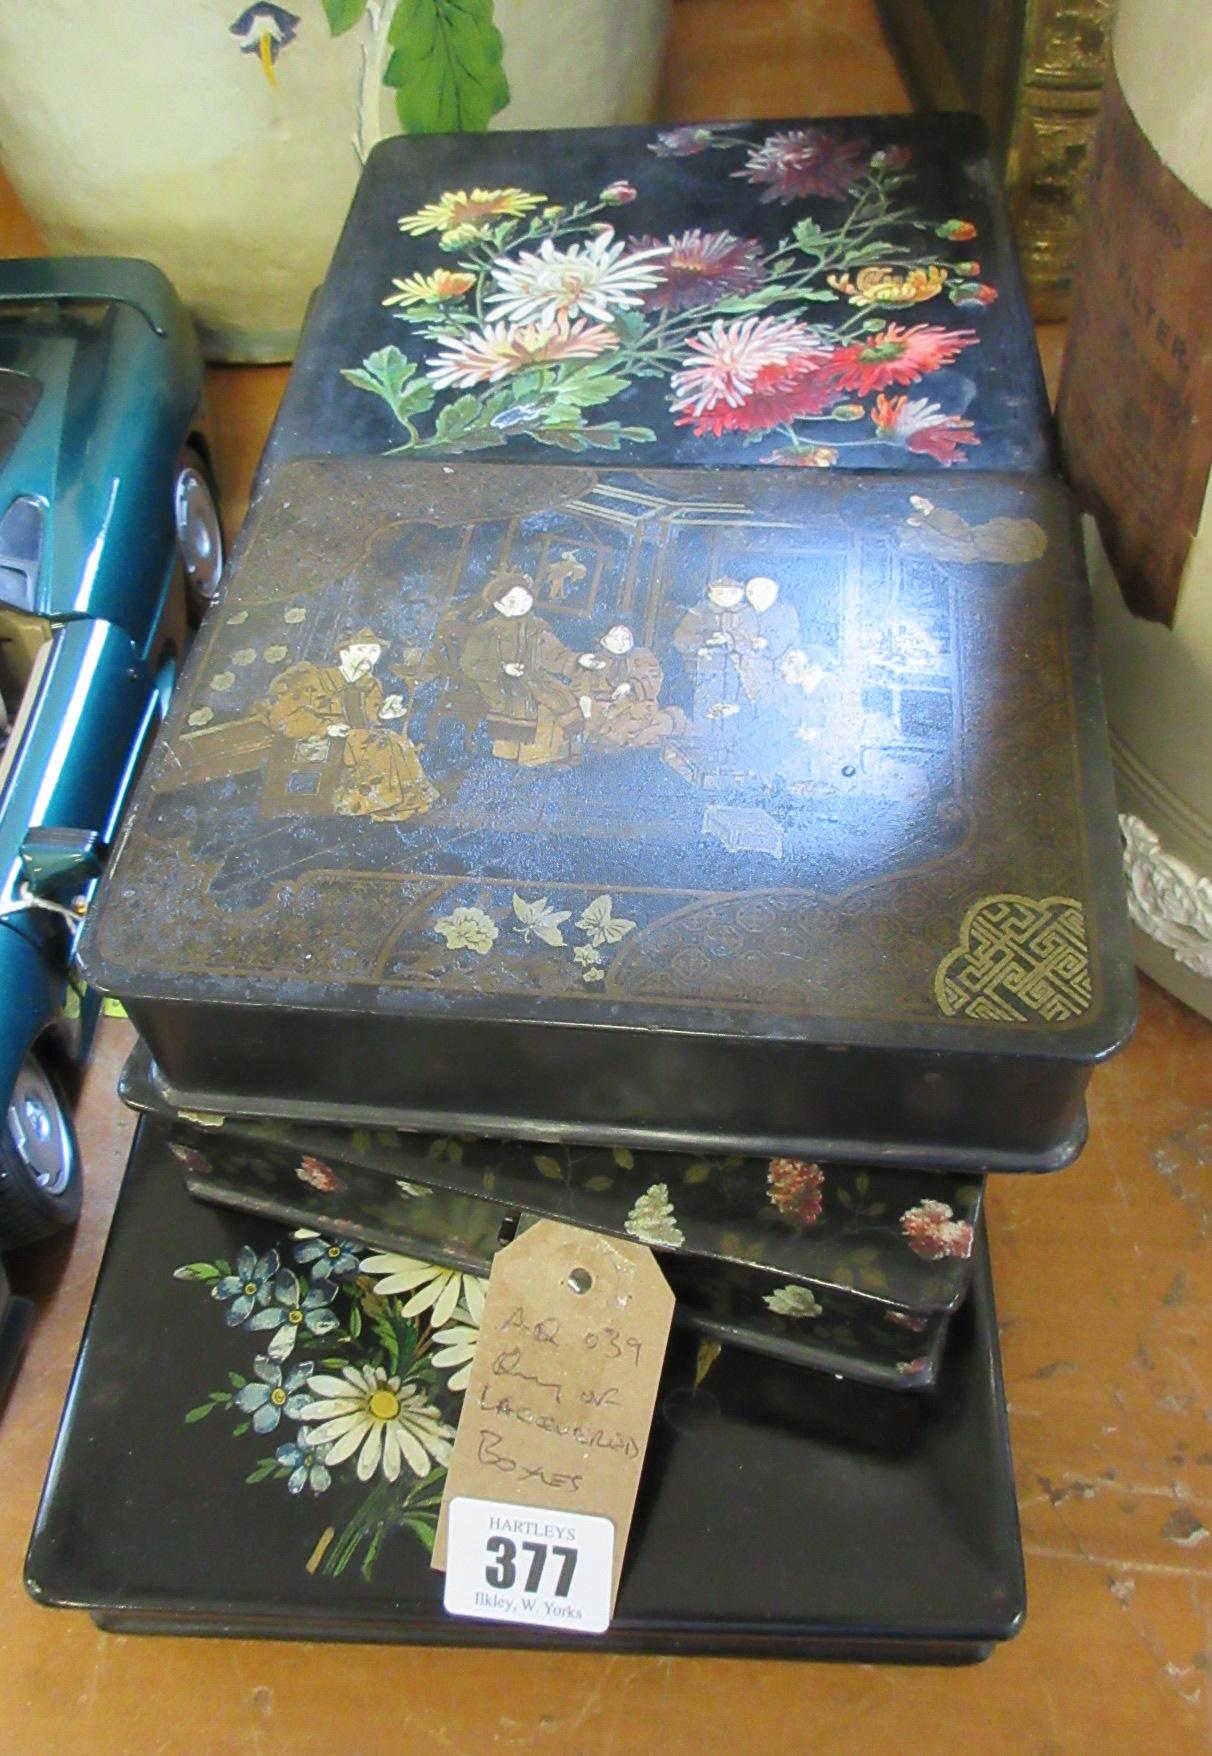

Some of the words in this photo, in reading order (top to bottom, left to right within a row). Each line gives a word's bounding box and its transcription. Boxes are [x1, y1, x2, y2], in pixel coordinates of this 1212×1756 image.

[584, 1327, 643, 1368] 039
[488, 1516, 577, 1541] HARTLEYS
[485, 1535, 579, 1599] 377
[474, 1591, 517, 1612] Ilkley,
[521, 1598, 540, 1612] W.
[544, 1600, 583, 1620] Yorks
